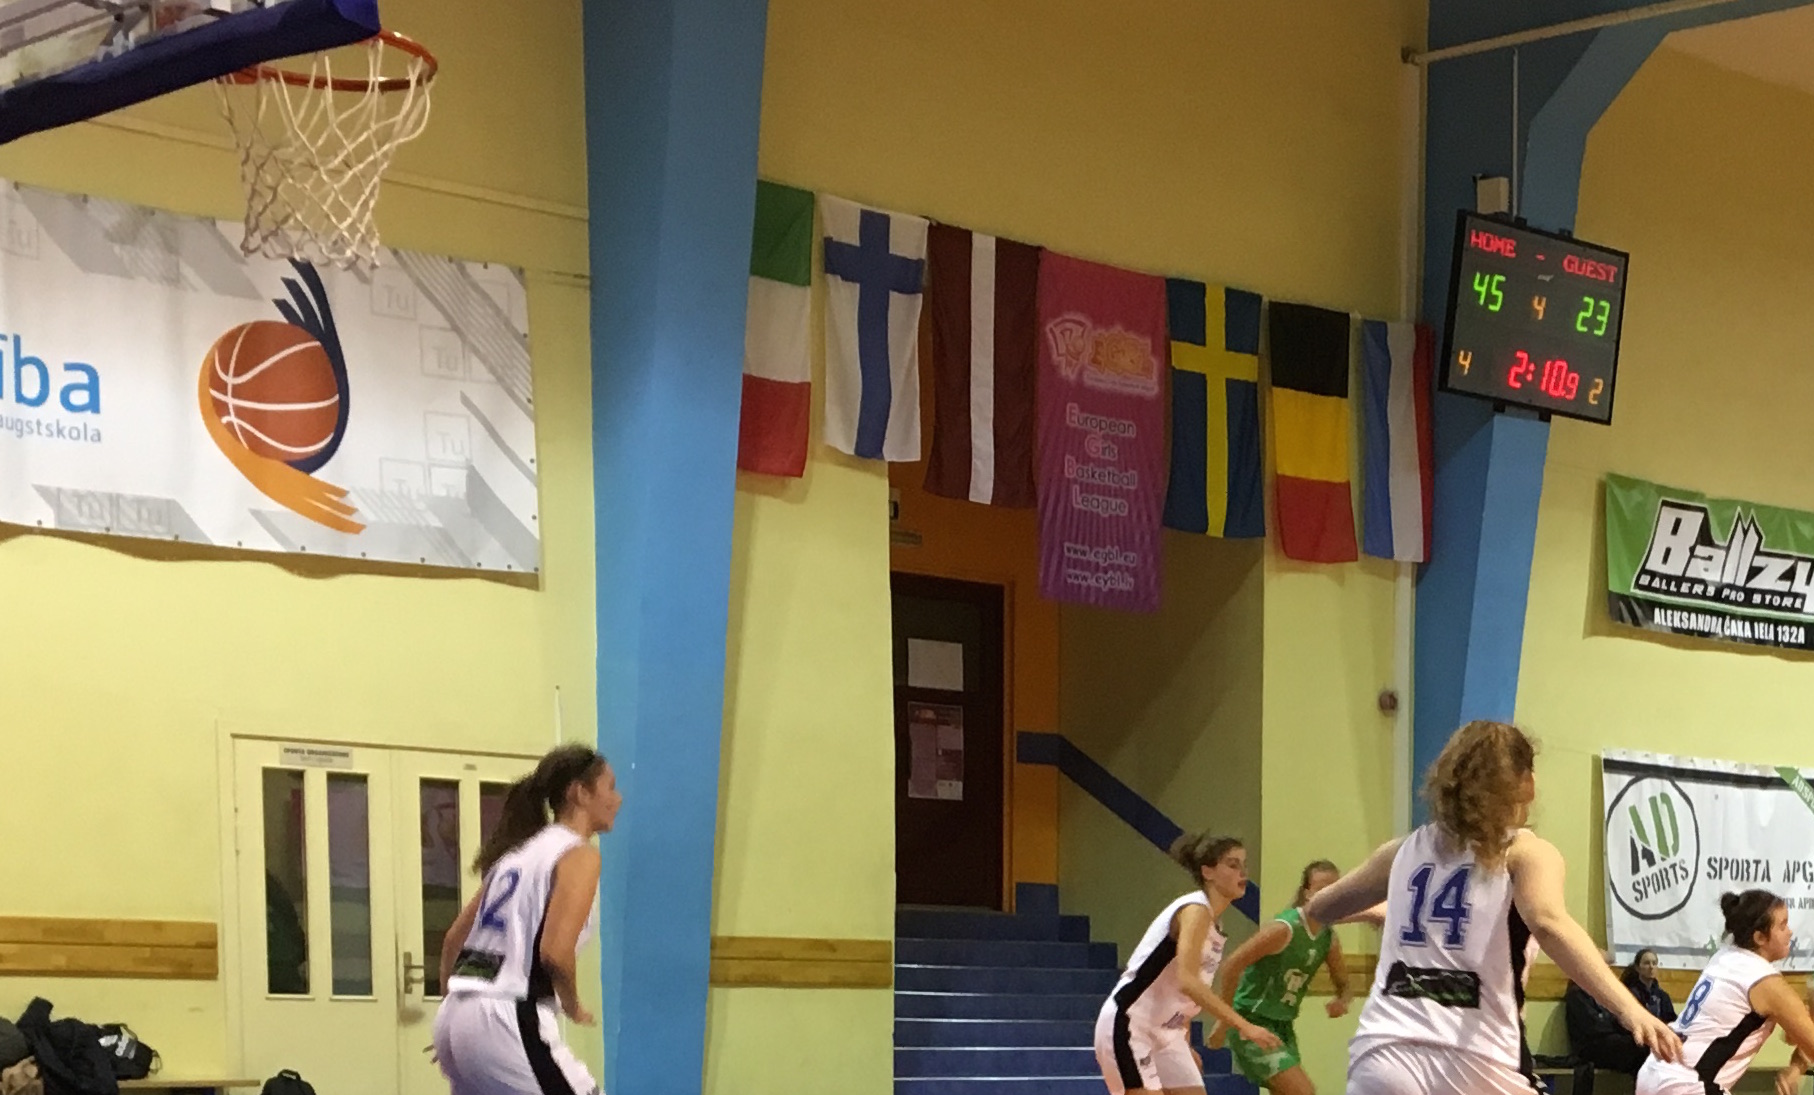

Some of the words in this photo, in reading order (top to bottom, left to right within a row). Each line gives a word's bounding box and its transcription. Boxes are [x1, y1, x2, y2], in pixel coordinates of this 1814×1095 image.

[1471, 230, 1516, 258] HOME
[1562, 254, 1618, 283] GUEST
[1473, 272, 1506, 312] 45
[1532, 296, 1546, 320] 4
[1576, 297, 1610, 336] 23
[1458, 350, 1472, 375] 4
[1588, 378, 1603, 405] 2
[1067, 404, 1135, 436] European
[1086, 435, 1117, 459] Girls
[1065, 456, 1136, 488] Basketball
[1073, 485, 1127, 515] League
[1639, 574, 1716, 597] BALLERS
[1721, 587, 1745, 602] PRO
[1752, 593, 1804, 609] STORE
[1653, 607, 1722, 637] ALEKSANDRA
[1777, 625, 1805, 644] 132A
[1628, 792, 1680, 876] AD
[1632, 859, 1689, 903] SPORTS
[1706, 856, 1771, 883] SPORTA
[1399, 863, 1475, 950] 14
[1678, 976, 1714, 1029] 8
